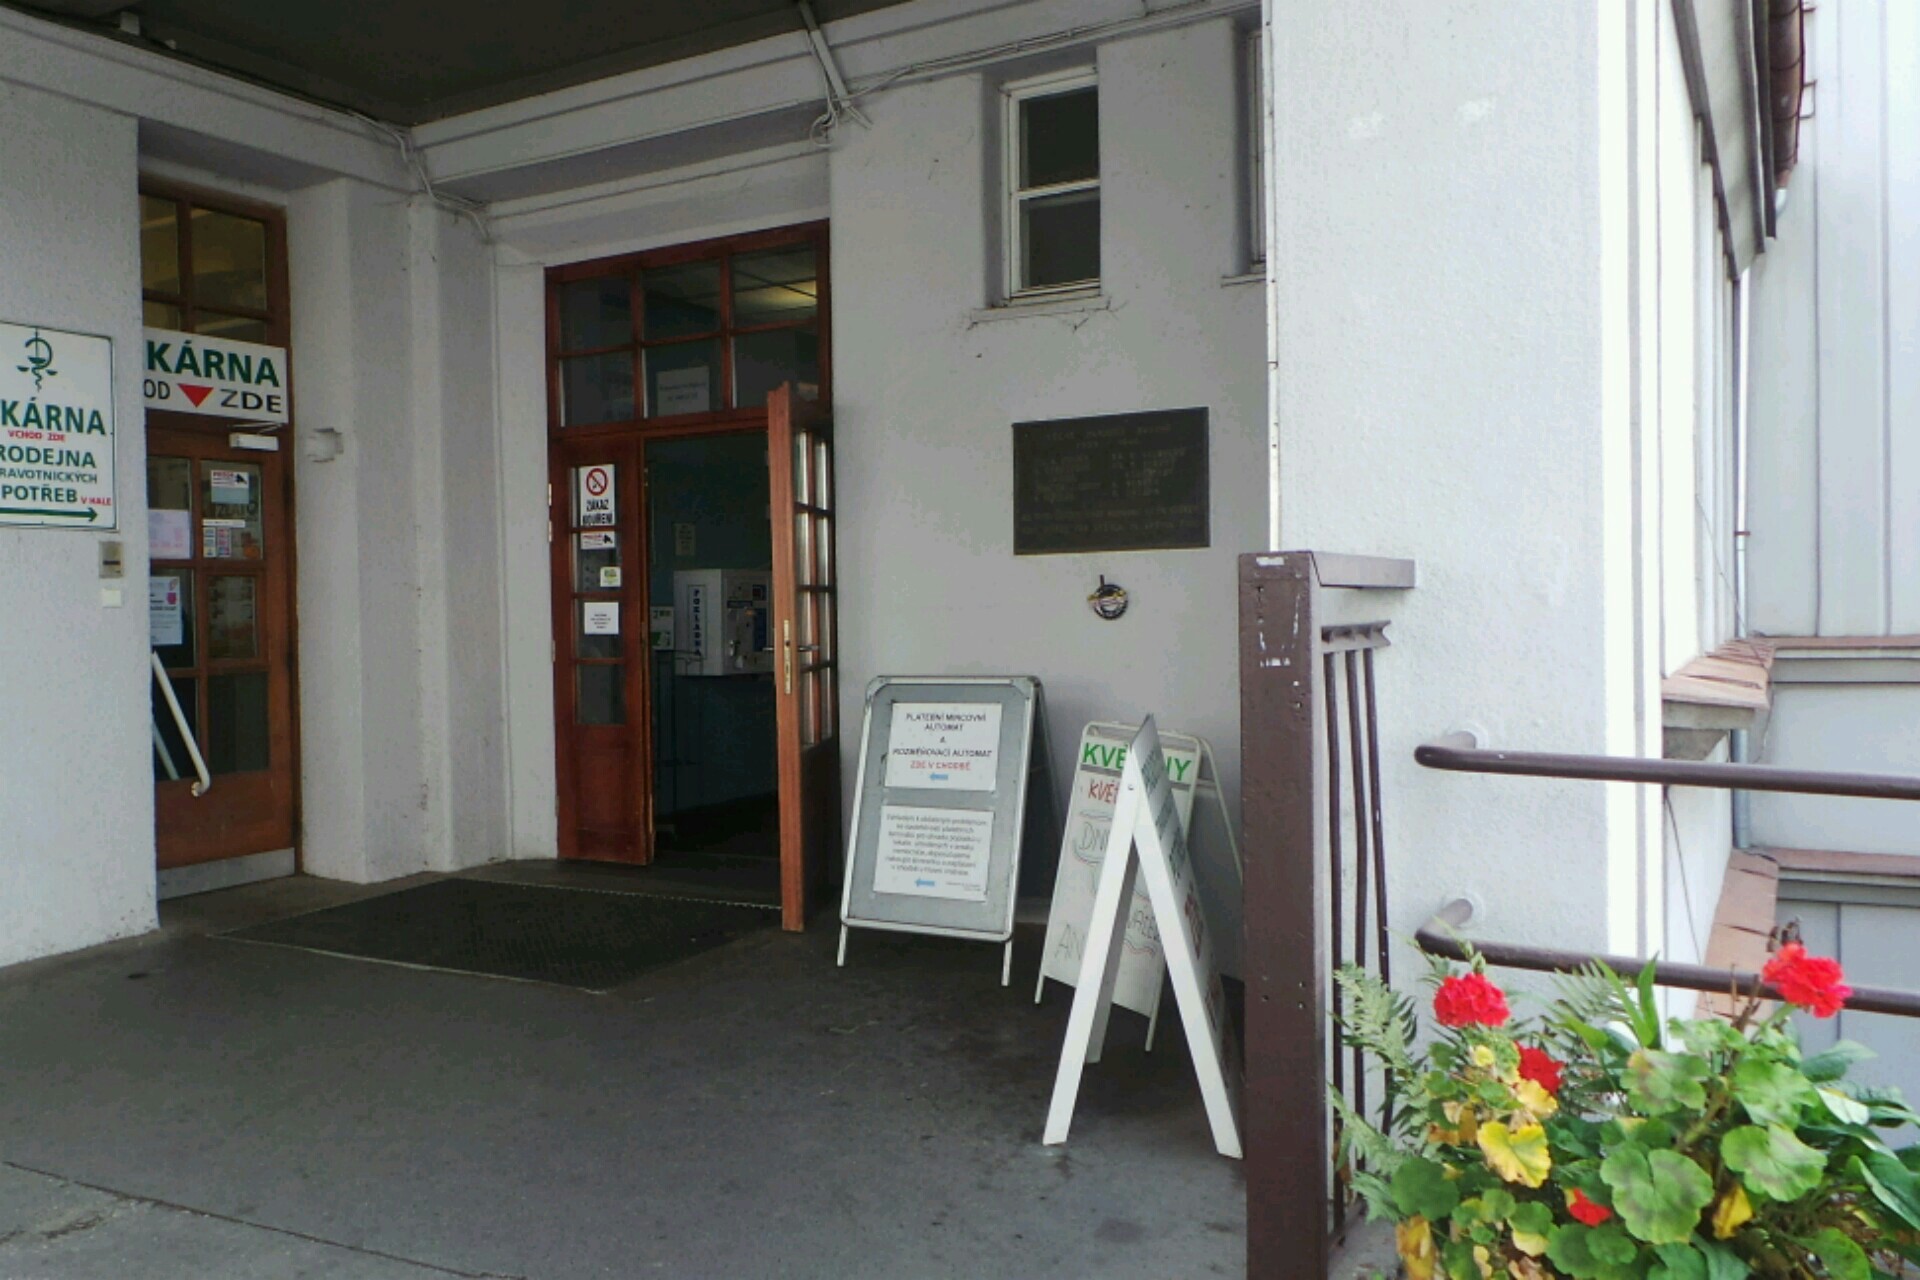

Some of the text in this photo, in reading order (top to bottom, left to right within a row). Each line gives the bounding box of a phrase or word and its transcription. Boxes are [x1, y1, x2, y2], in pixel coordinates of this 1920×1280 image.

[147, 339, 280, 388] KÁRNA
[220, 388, 282, 414] ZDE
[0, 396, 107, 436] KÁRNA
[8, 430, 66, 441] VCHOD ZDE
[1, 483, 78, 503] POTŘEB
[81, 496, 88, 504] V
